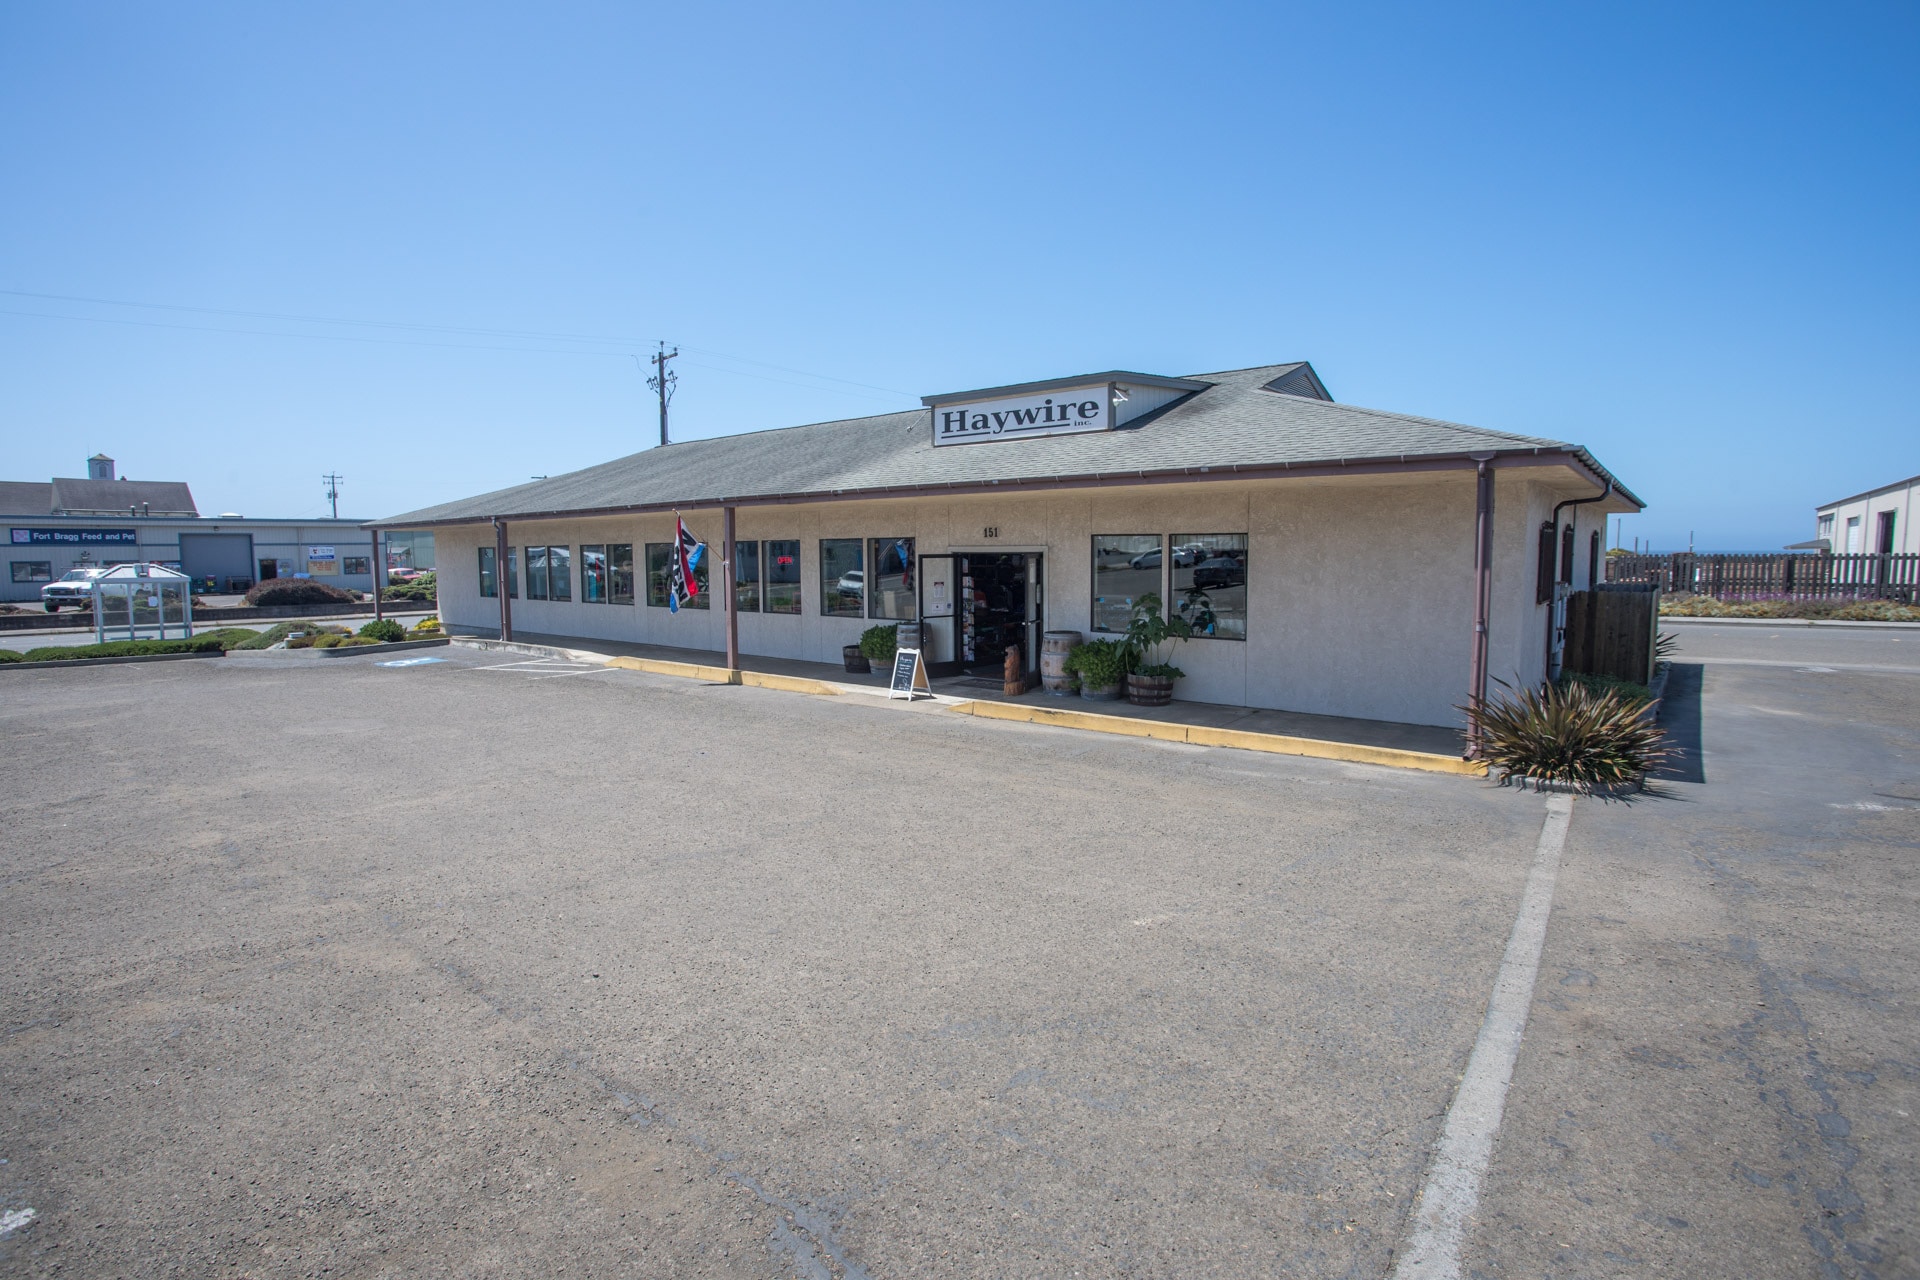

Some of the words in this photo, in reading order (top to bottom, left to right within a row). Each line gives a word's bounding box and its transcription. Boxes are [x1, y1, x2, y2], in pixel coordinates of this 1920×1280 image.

[941, 398, 1099, 434] Haywire
[1073, 419, 1092, 427] inc.
[33, 532, 51, 540] Fort
[54, 532, 79, 542] Bragg
[82, 532, 102, 540] Feed
[984, 527, 998, 538] 151
[777, 556, 793, 565] OPEN
